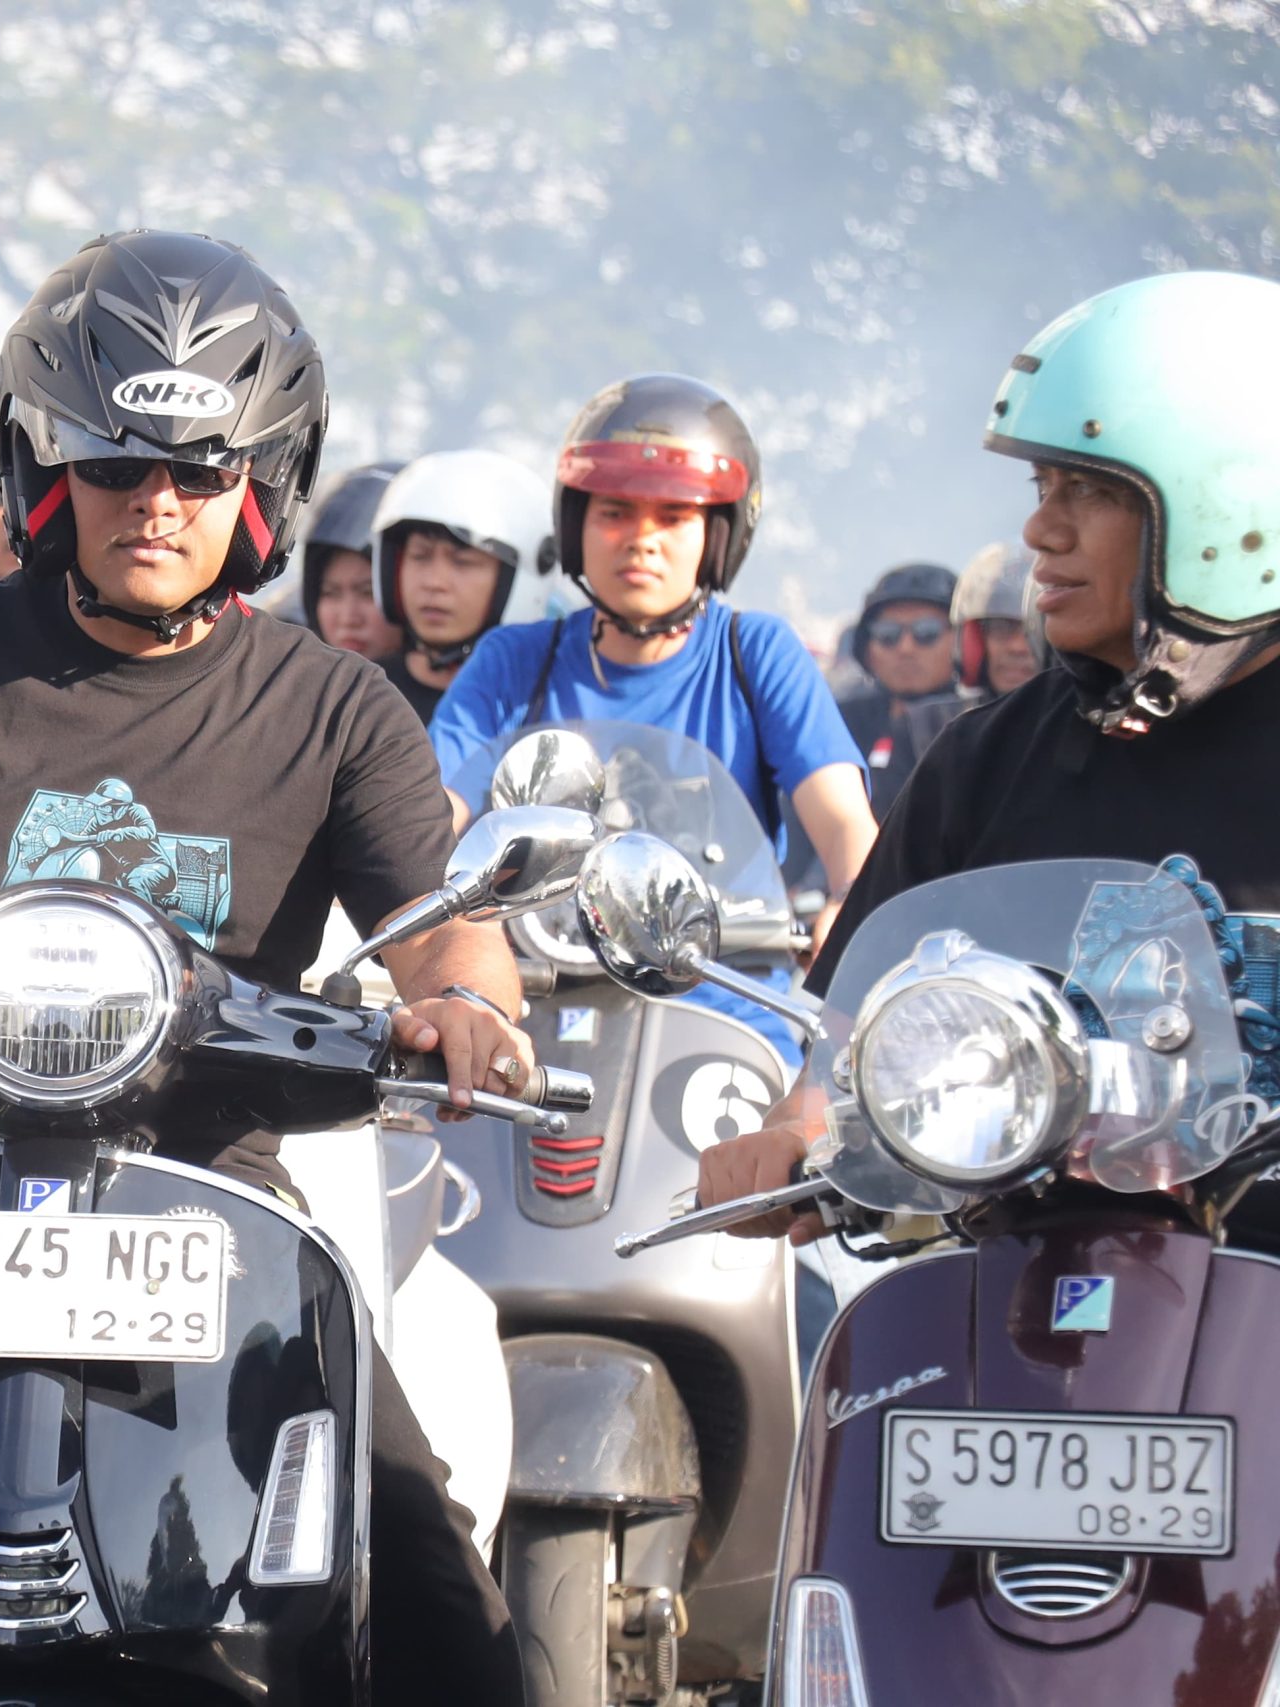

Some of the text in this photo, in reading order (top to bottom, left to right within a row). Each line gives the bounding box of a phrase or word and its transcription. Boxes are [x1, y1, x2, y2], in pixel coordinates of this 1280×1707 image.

[106, 1230, 209, 1284] NGC
[905, 1428, 1215, 1496] S 5978 JBZ
